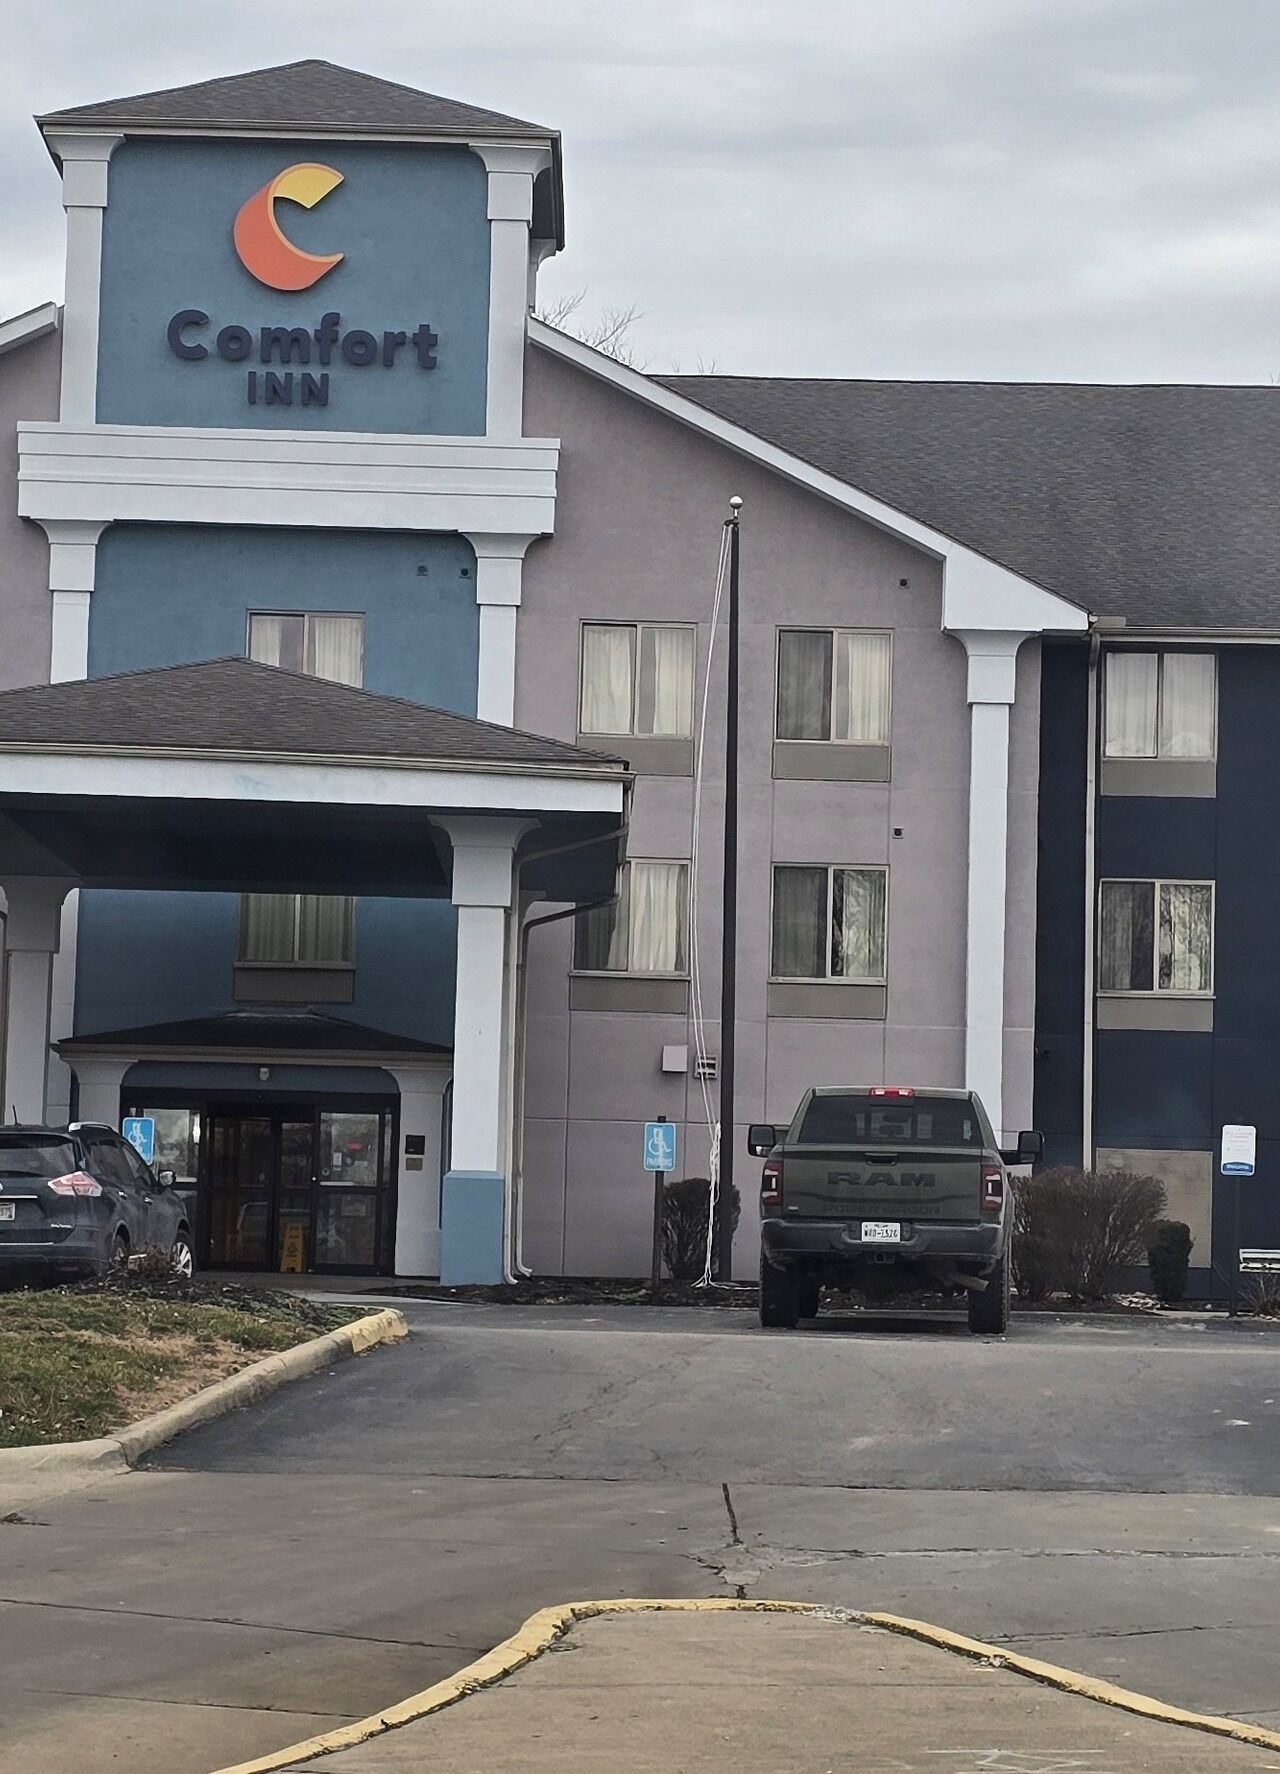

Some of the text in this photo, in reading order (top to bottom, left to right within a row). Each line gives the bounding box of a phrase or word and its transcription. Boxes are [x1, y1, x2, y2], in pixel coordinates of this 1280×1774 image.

[166, 309, 438, 370] Comfort
[247, 371, 330, 406] INN
[827, 1171, 936, 1187] RAM
